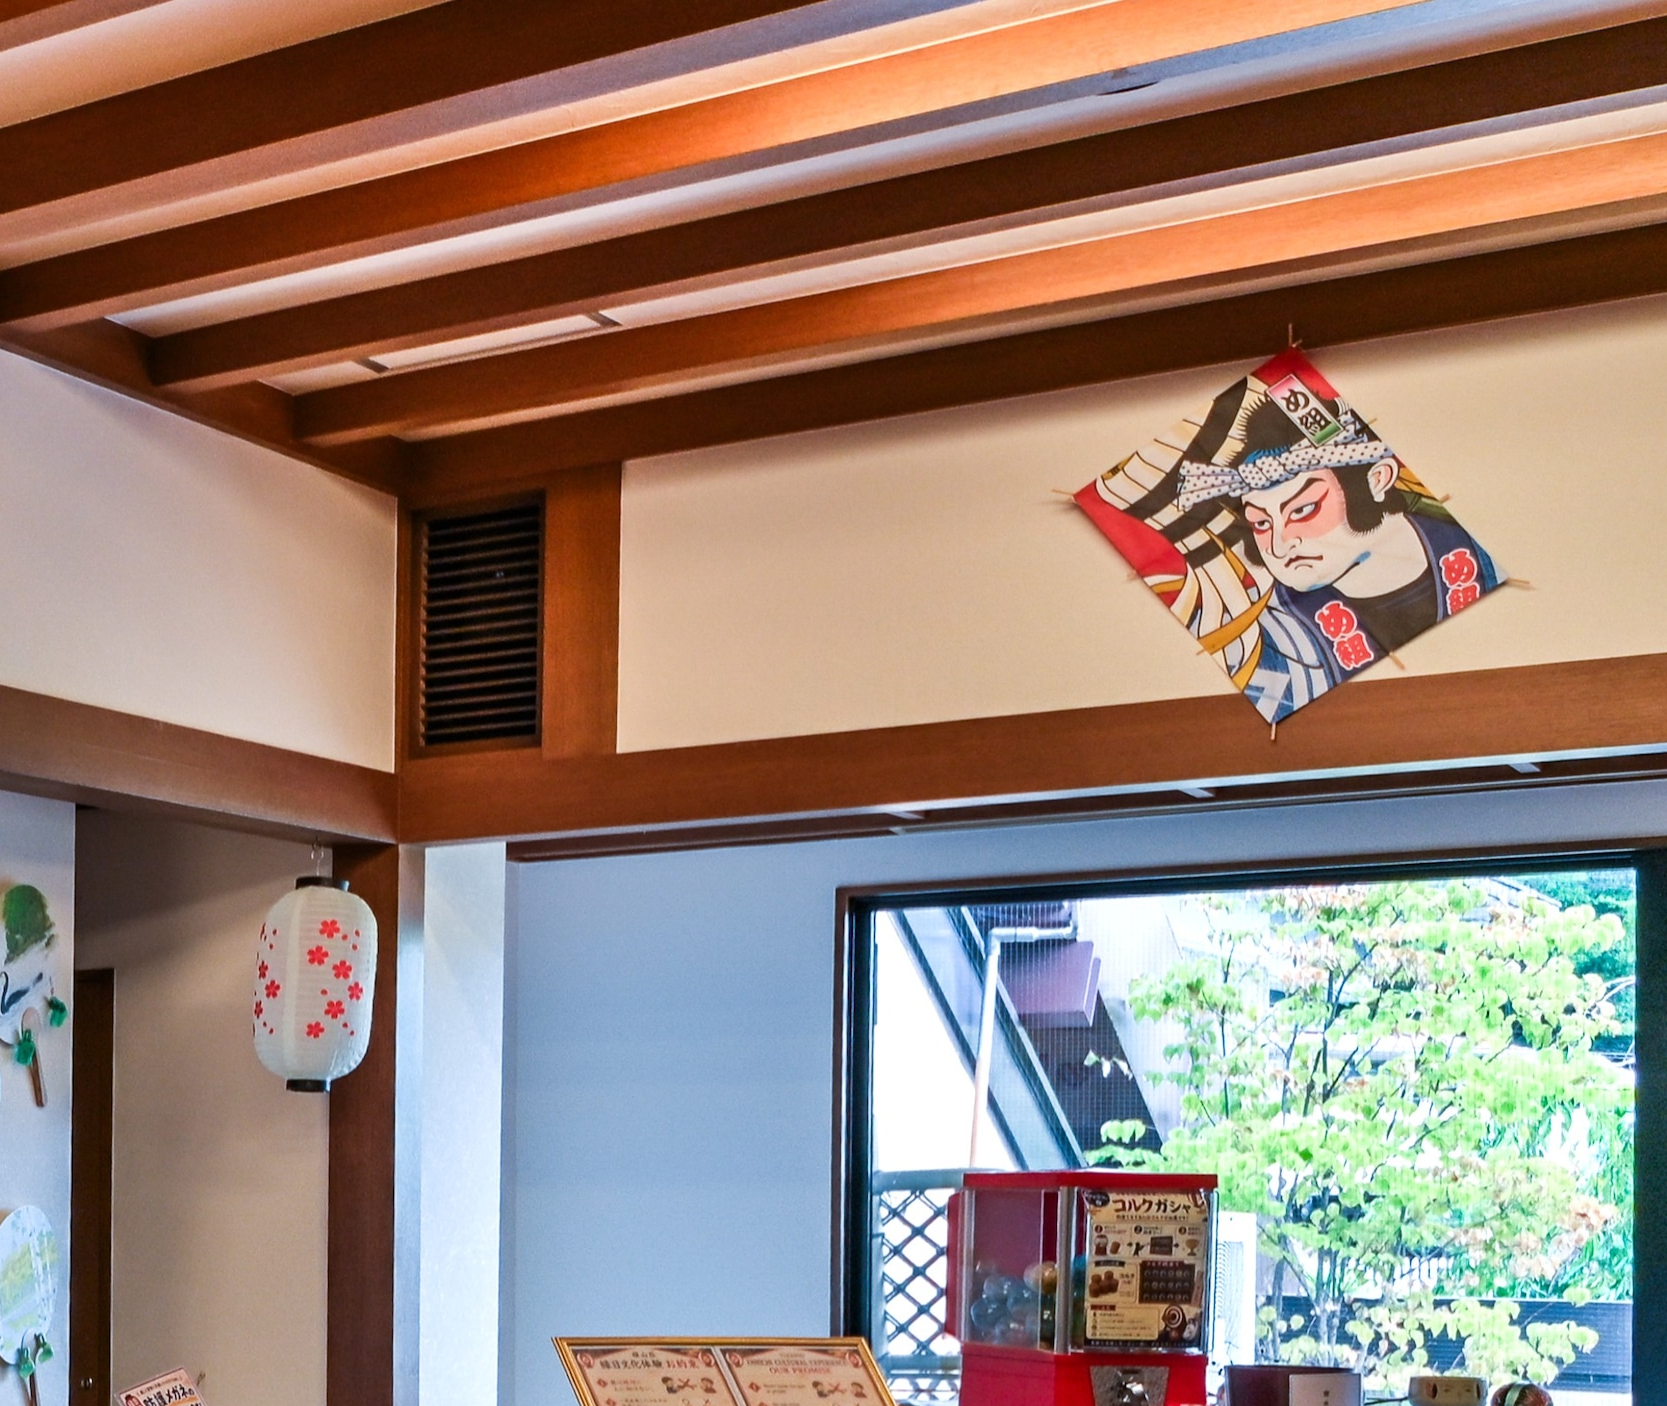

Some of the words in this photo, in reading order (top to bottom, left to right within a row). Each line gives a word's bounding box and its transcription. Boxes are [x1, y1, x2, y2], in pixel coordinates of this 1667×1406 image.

[1112, 1197, 1192, 1214] コルクガシャ
